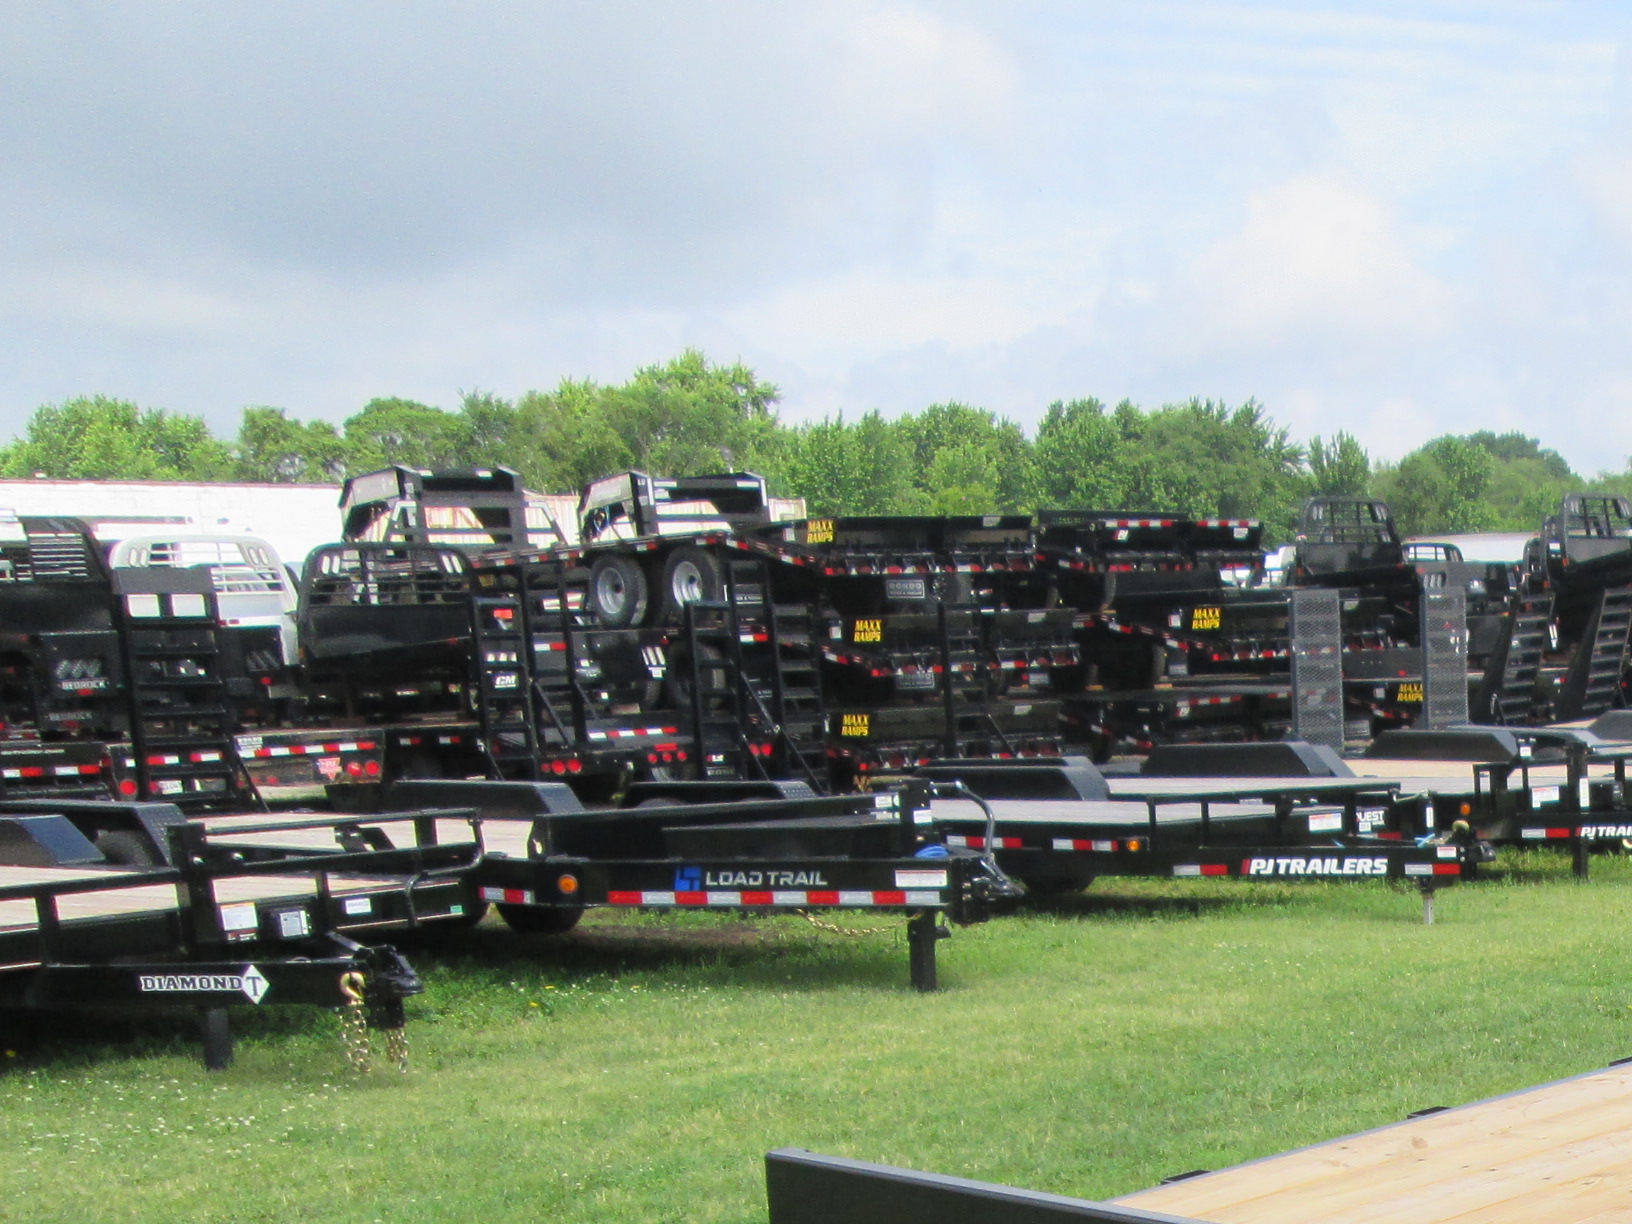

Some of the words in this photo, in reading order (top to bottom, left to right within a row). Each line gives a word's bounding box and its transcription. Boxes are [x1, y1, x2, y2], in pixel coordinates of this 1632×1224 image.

[807, 520, 833, 531] MAXX
[807, 532, 833, 543] RAMPS
[1193, 608, 1220, 619] MAXX
[855, 620, 882, 631] MAXX
[1192, 619, 1220, 630] RAMPS
[853, 631, 881, 643] RAMPS
[61, 680, 106, 690] BEDROCK
[842, 714, 869, 726] MAXX
[841, 725, 869, 736] RAMPS
[705, 871, 763, 886] LOAD
[766, 871, 829, 886] TRAIL
[140, 975, 242, 991] DIAMOND
